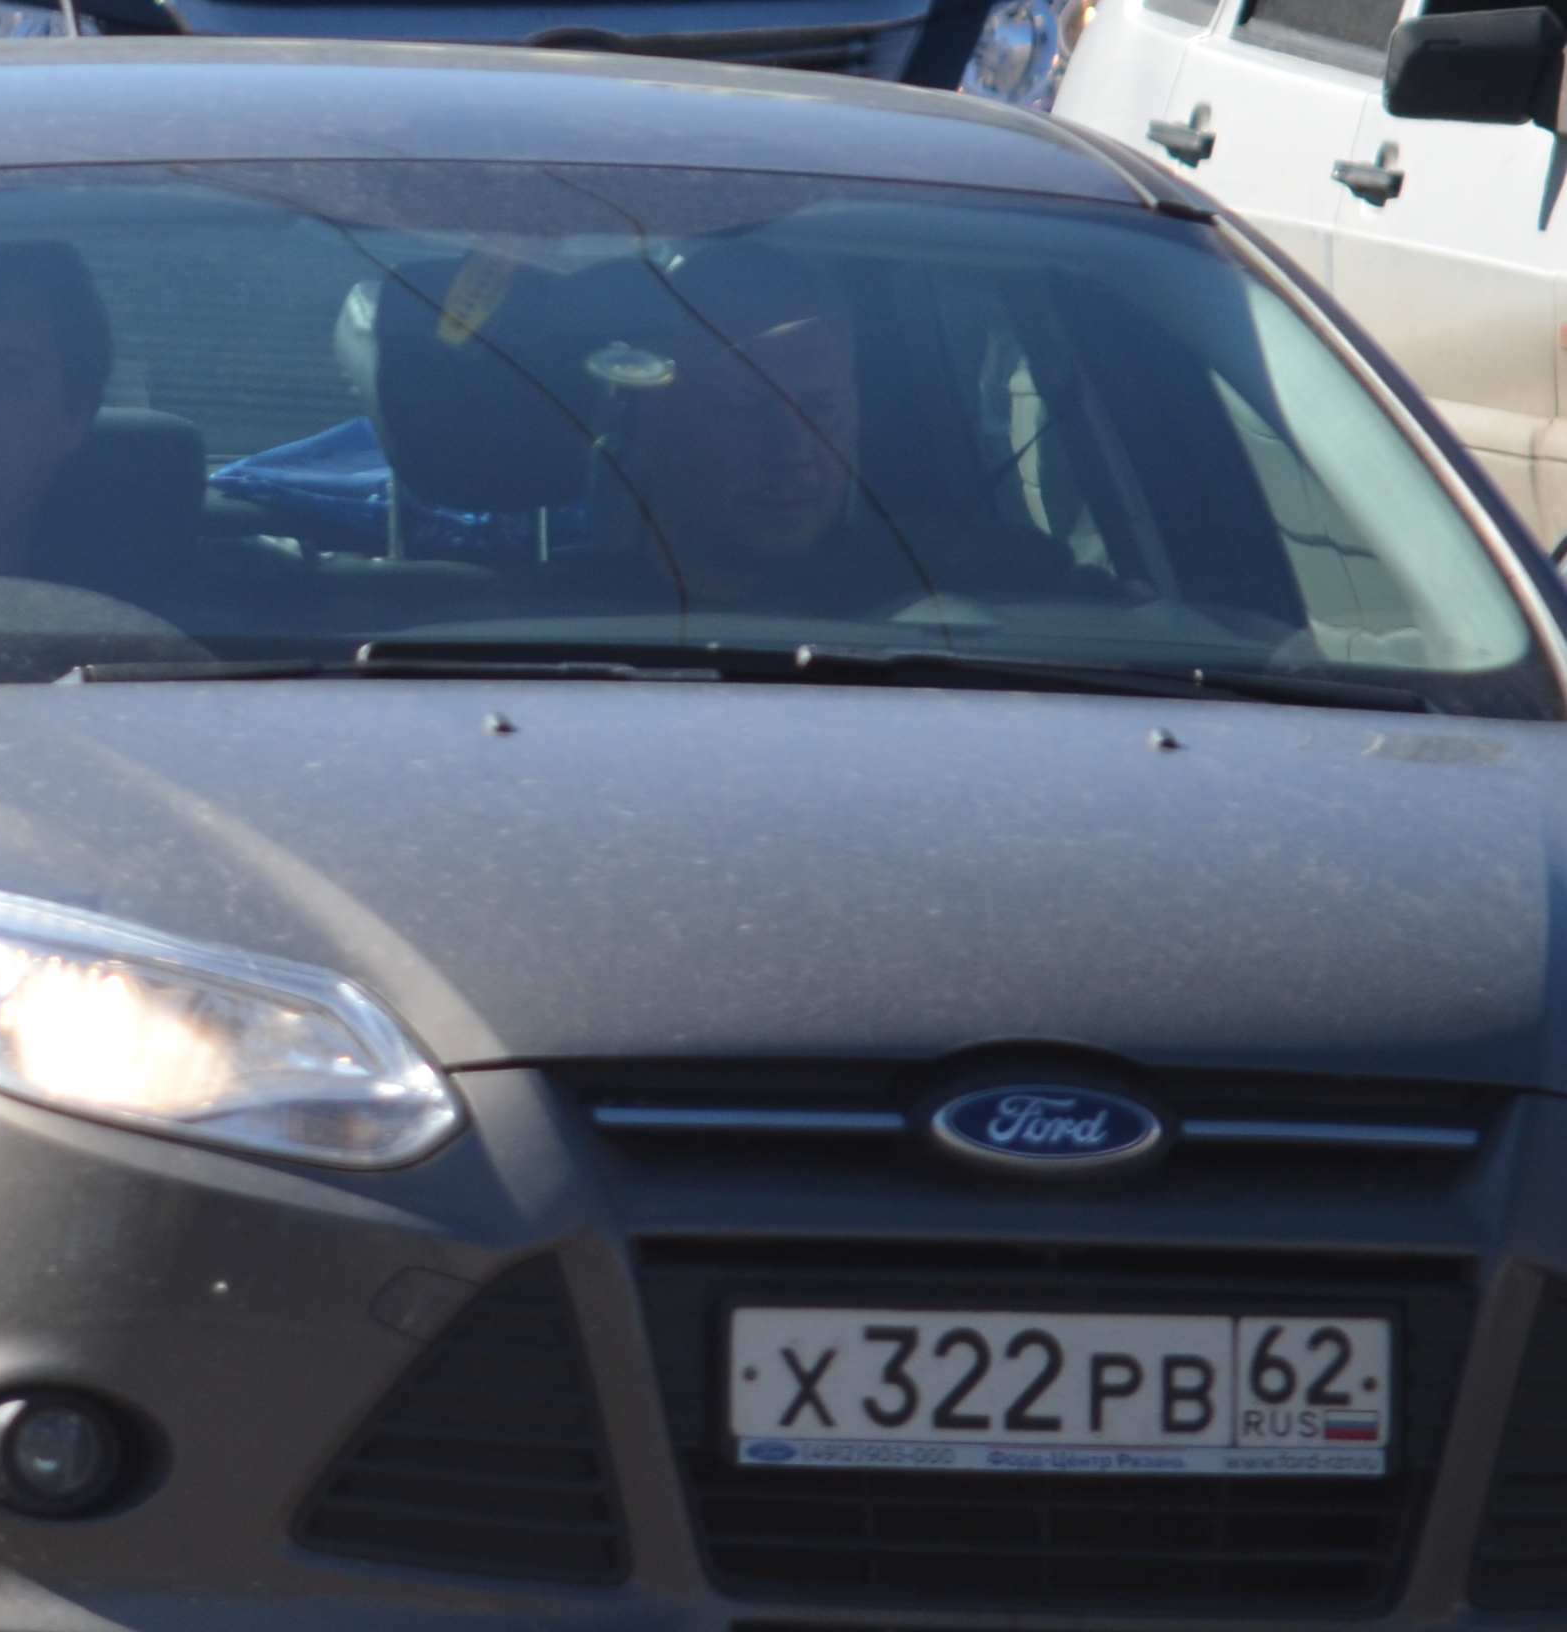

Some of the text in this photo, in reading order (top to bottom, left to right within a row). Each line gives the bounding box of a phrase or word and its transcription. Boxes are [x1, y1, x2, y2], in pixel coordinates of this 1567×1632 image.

[987, 1094, 1108, 1143] Ford
[1248, 1325, 1352, 1407] 62
[1242, 1411, 1319, 1438] RUS
